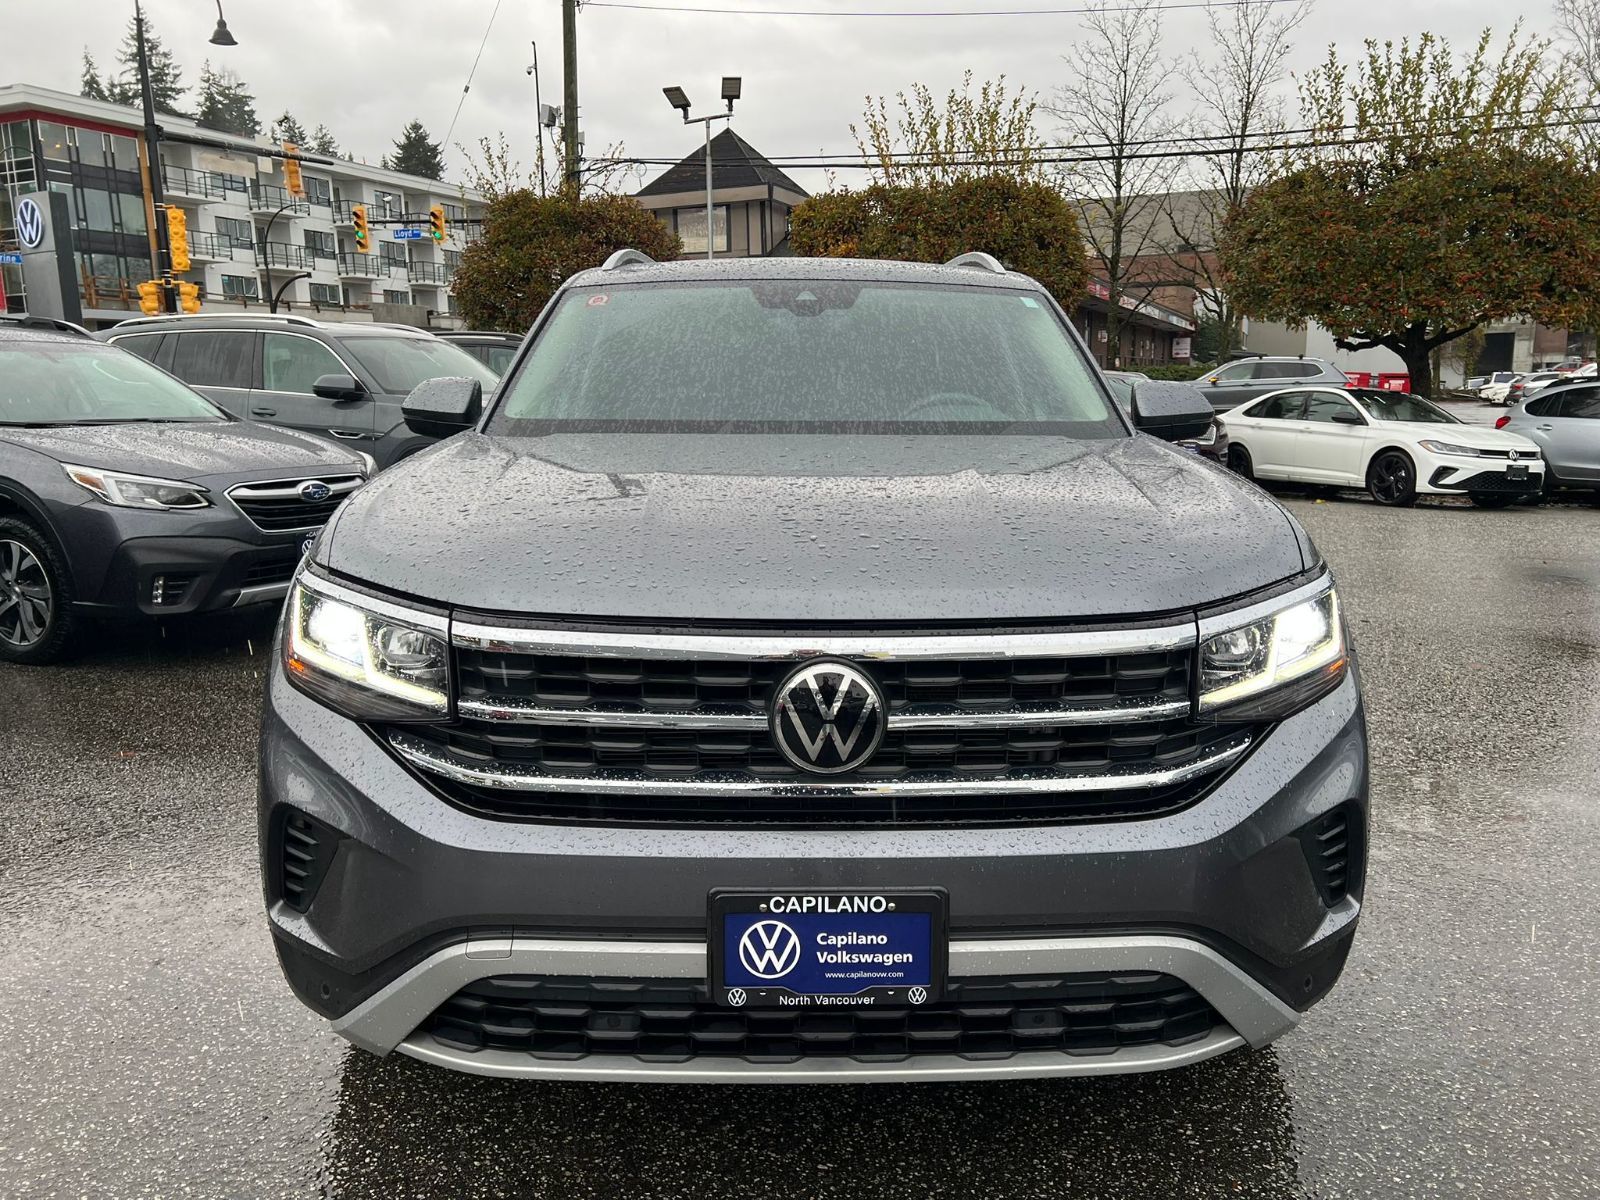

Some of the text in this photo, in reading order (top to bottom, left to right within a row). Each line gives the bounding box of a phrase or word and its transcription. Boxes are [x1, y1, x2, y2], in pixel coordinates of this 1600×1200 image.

[394, 229, 413, 238] Lloyd
[775, 663, 882, 773] VW
[769, 896, 887, 913] CAPILANO
[816, 932, 888, 948] Capilano
[739, 920, 800, 979] VW
[816, 951, 913, 966] Volkswagen
[824, 970, 904, 979] www.capilanovw.com
[779, 995, 875, 1005] North Vancouver
